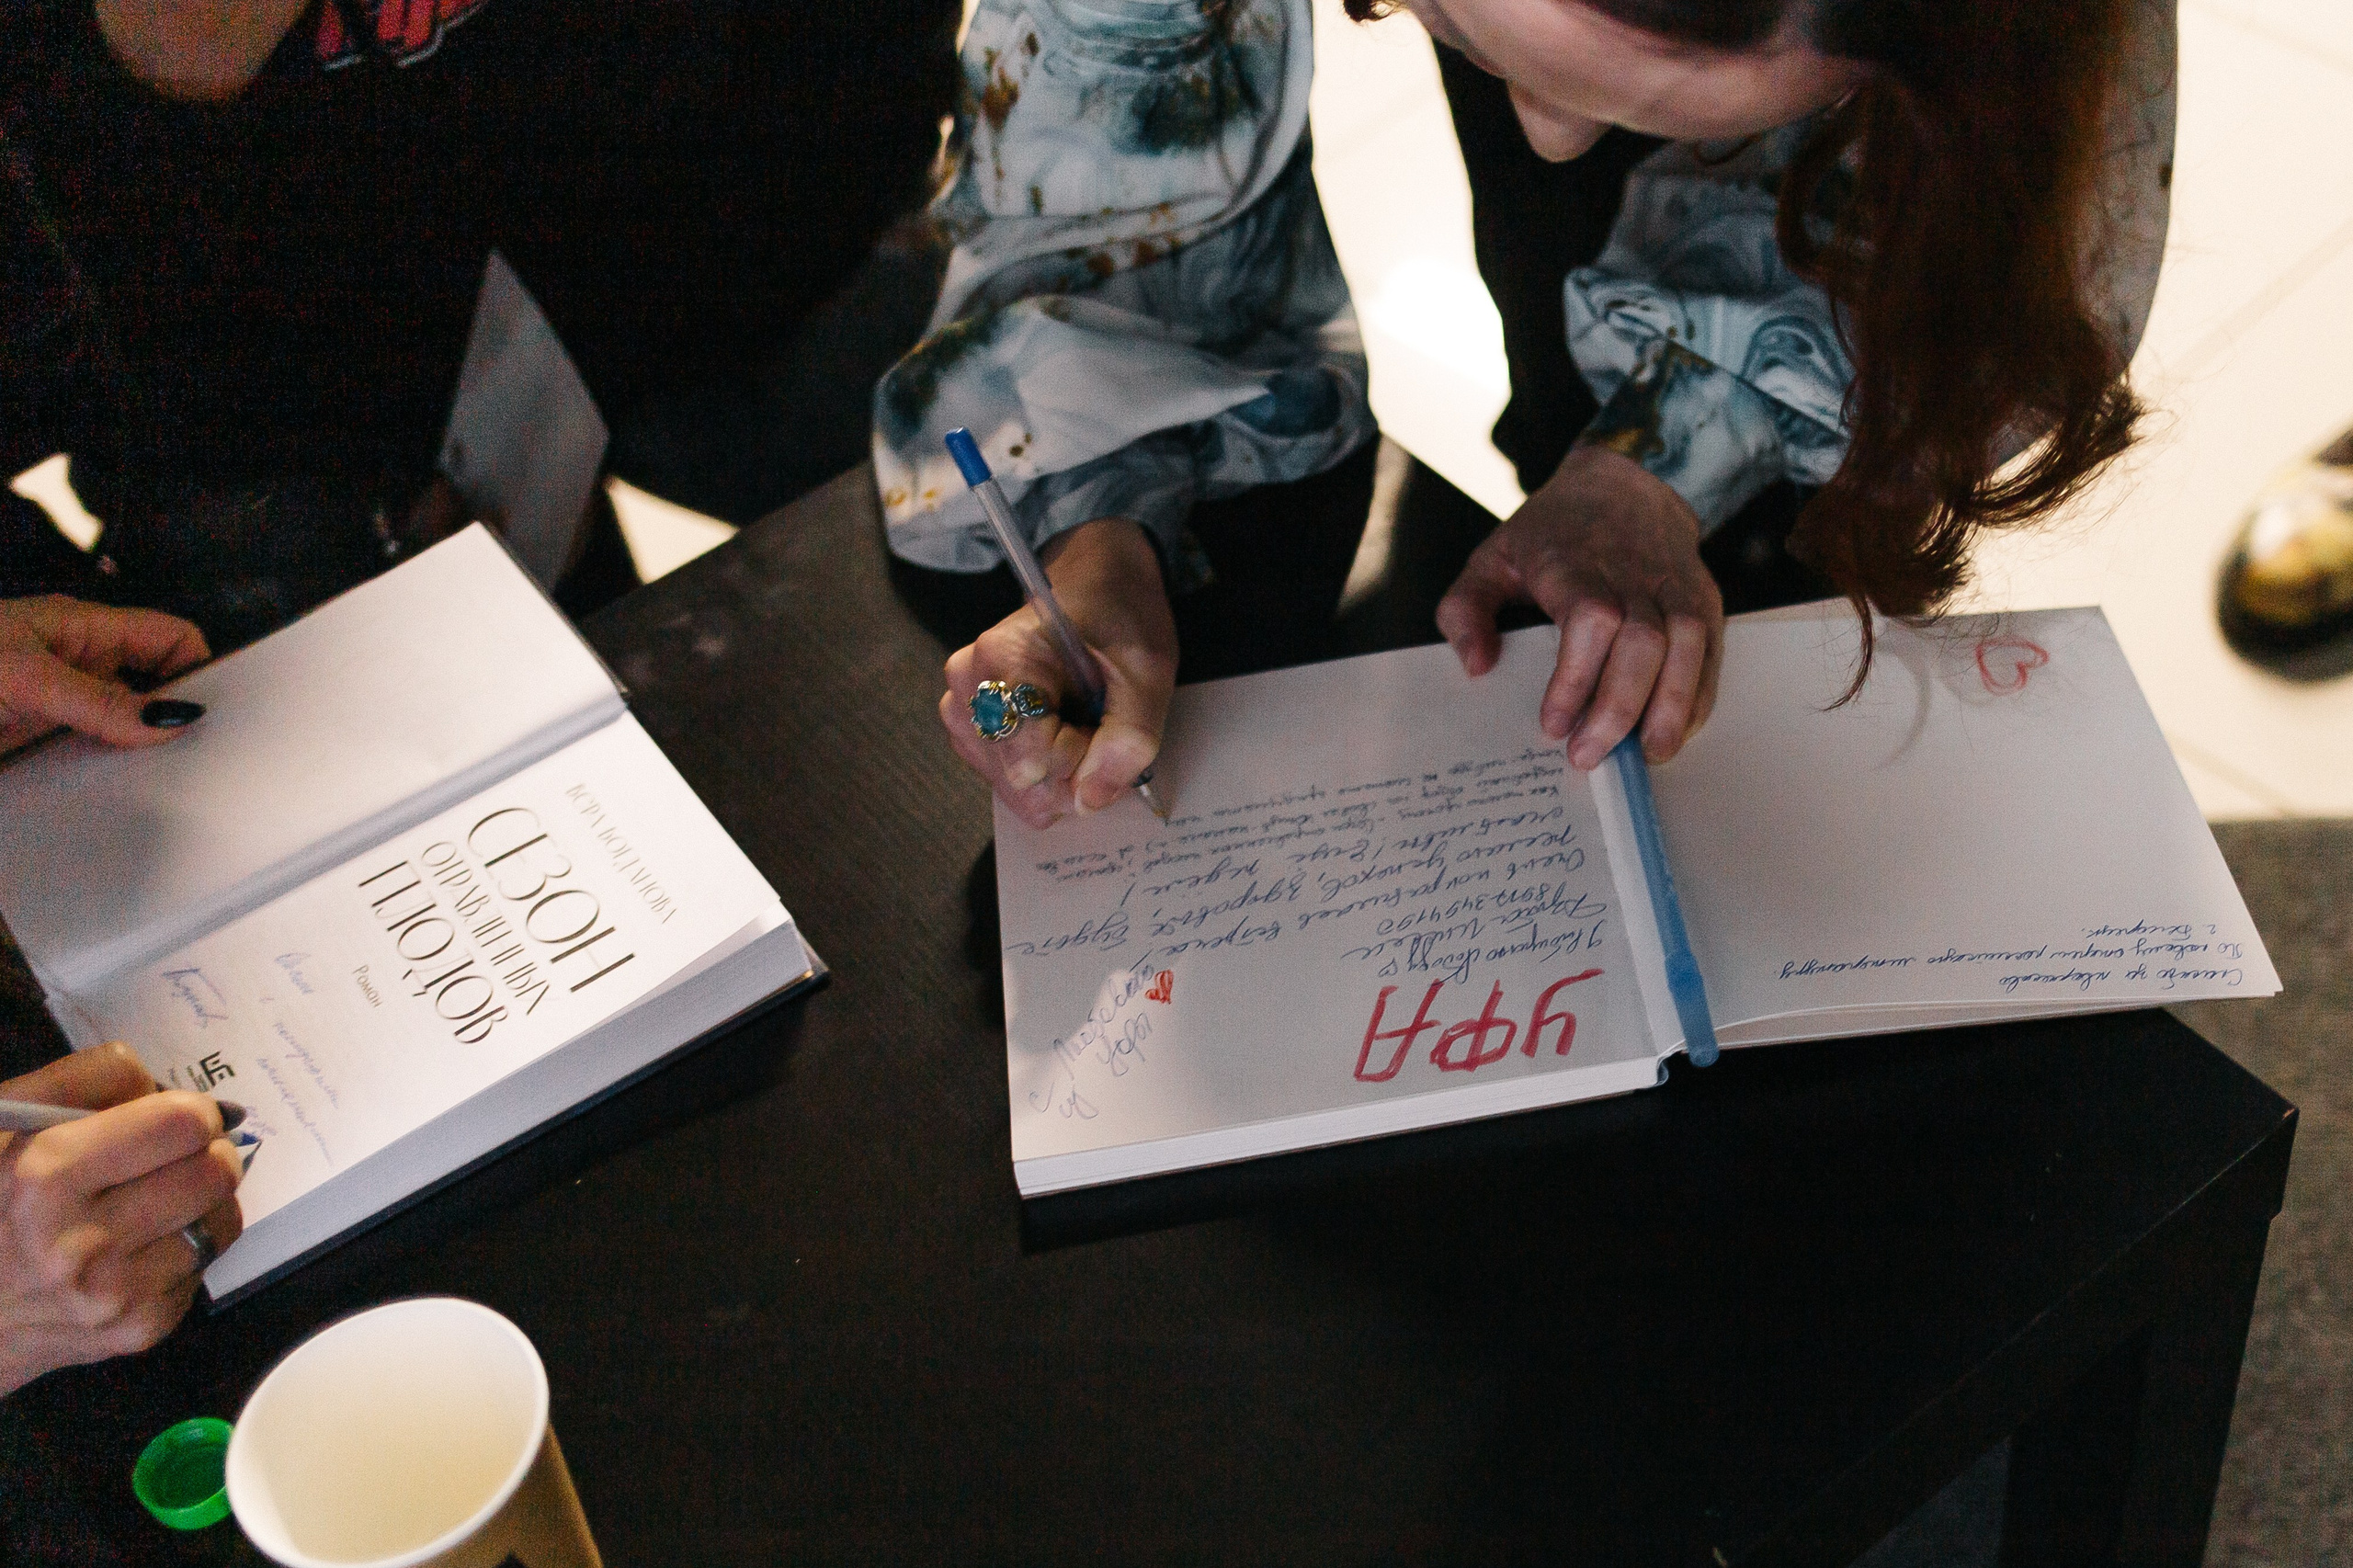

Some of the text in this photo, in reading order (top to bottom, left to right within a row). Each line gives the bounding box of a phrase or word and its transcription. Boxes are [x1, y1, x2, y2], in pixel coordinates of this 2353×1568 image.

[1457, 824, 1575, 861] желаю
[1507, 847, 1585, 880] Очень
[467, 807, 636, 994] СЕЗОН
[422, 842, 550, 1015] ОТРАВЛЕННЫХ
[1006, 913, 1130, 953] будьте
[357, 859, 507, 1045] ПЛОДОВ
[1927, 946, 2047, 964] российскую
[2131, 936, 2208, 960] новому
[2219, 942, 2242, 960] По
[353, 964, 381, 1007] Роман
[1999, 963, 2242, 994] Спасибо за творчество
[1354, 968, 1605, 1083] УФА
